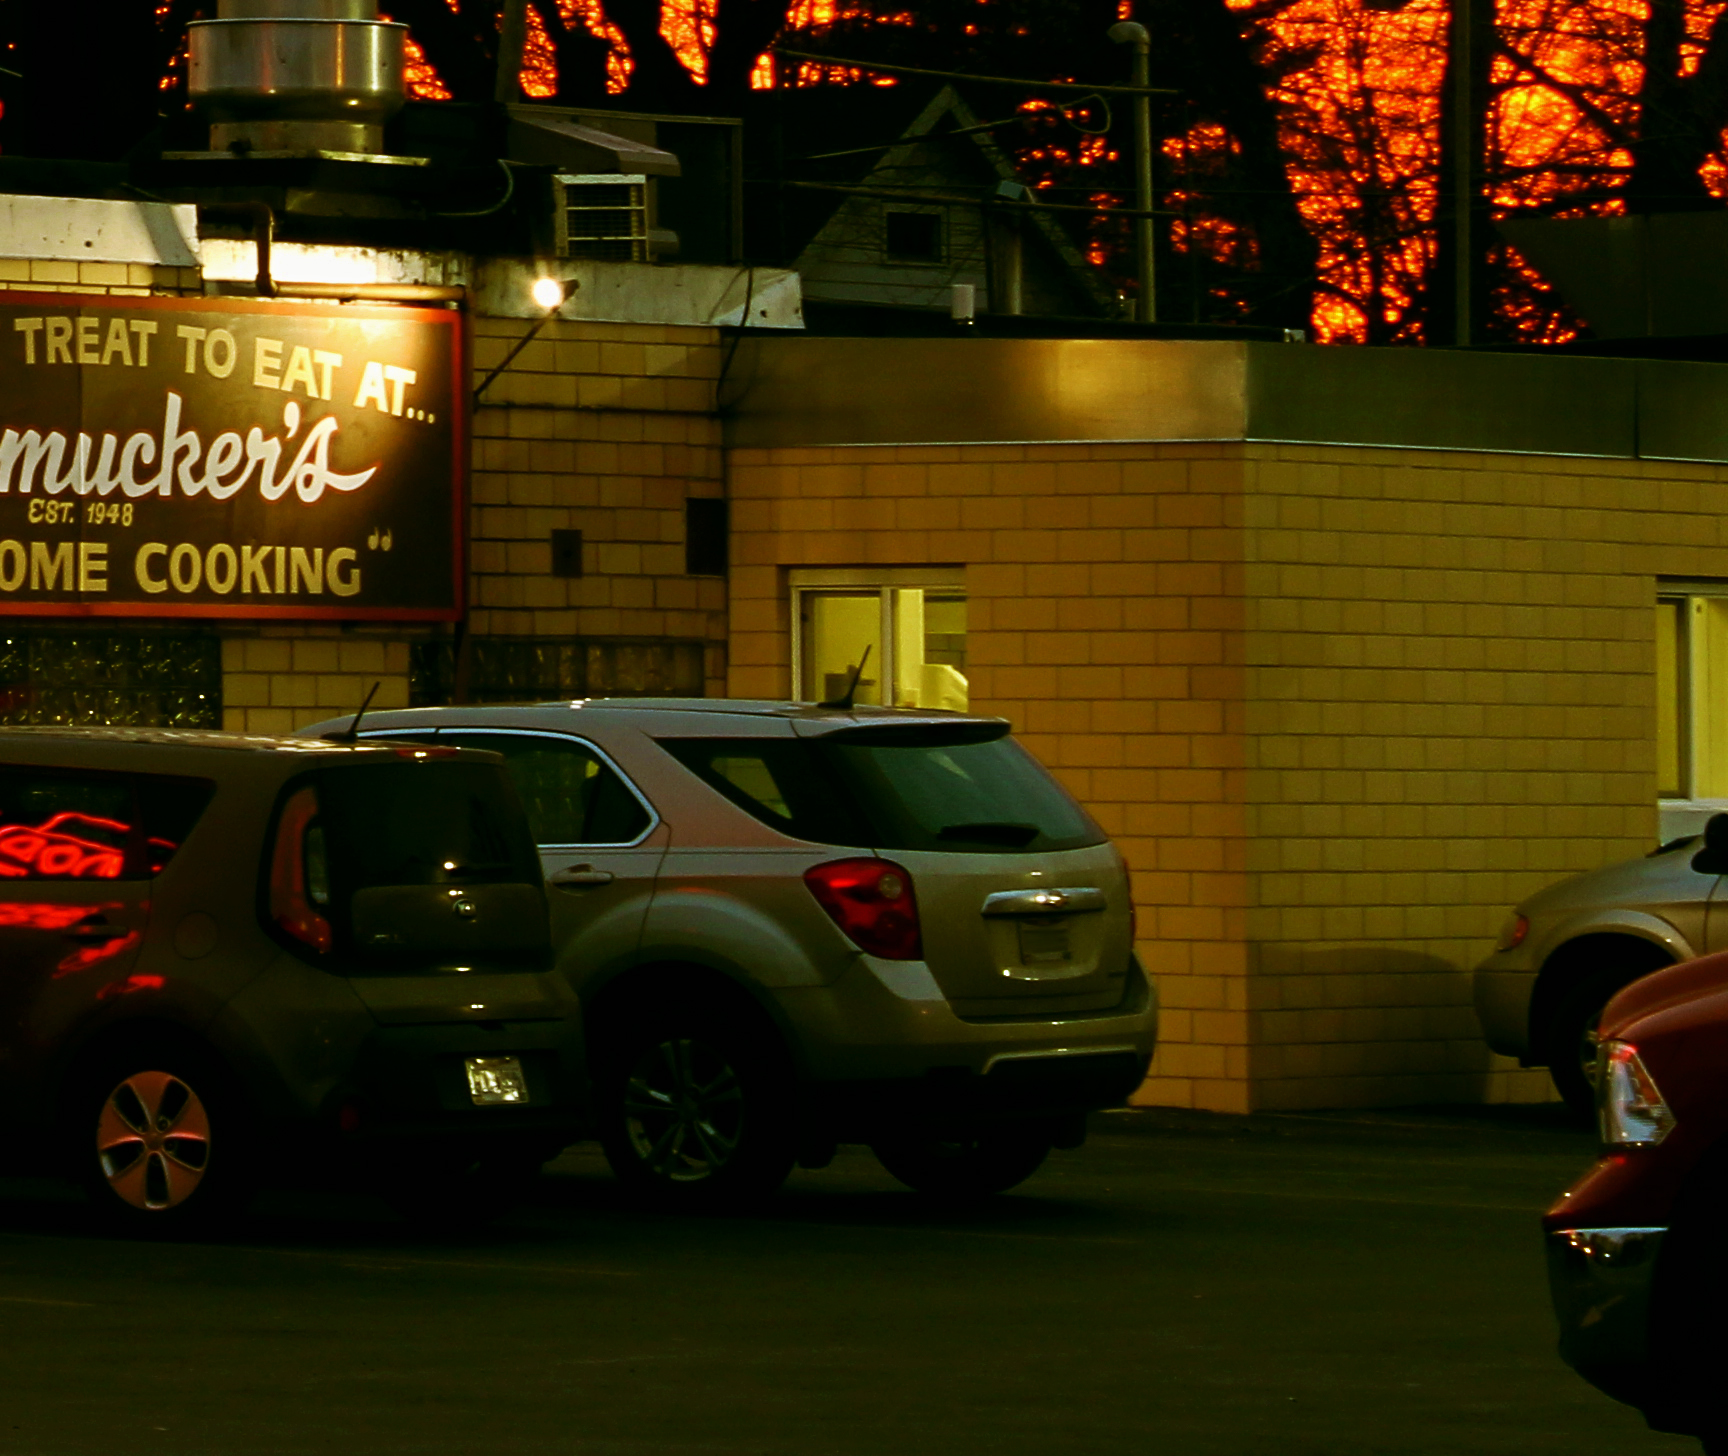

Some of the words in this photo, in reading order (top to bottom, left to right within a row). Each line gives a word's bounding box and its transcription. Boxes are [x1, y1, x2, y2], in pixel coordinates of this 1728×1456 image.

[14, 316, 158, 367] TREAT
[177, 324, 238, 379] TO
[253, 337, 343, 401] EAT
[353, 360, 436, 425] AT...
[27, 498, 75, 524] EST.
[87, 501, 134, 527] 1948
